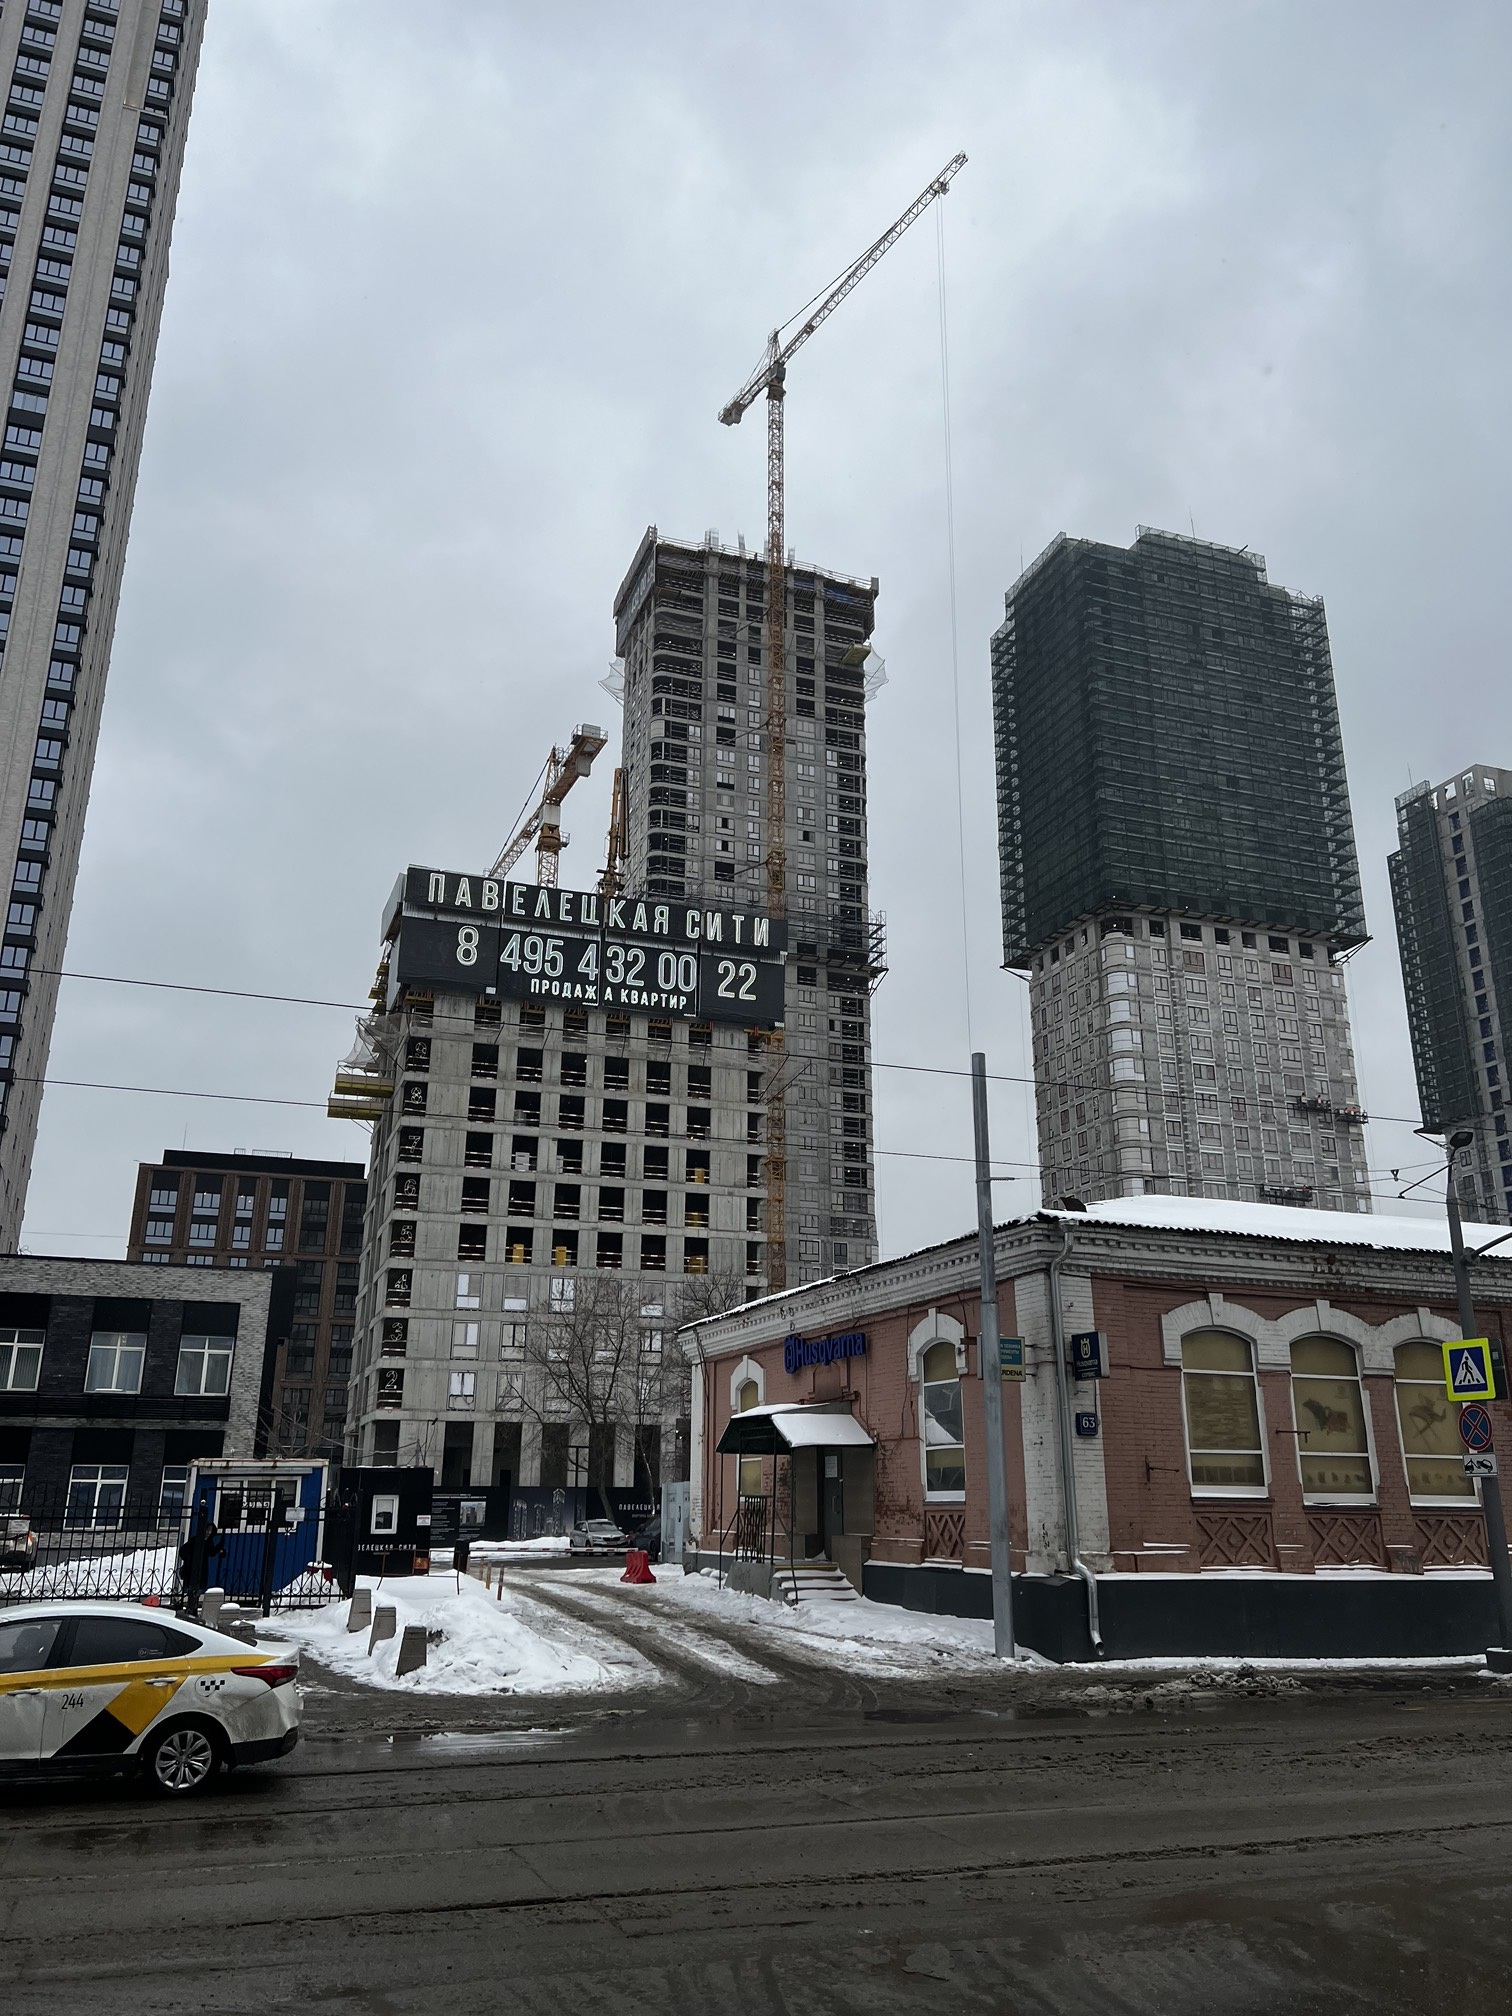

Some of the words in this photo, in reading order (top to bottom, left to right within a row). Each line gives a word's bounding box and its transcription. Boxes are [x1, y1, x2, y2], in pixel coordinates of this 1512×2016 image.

[428, 873, 670, 935] ПАВЕЛЕЦКАЯ
[686, 909, 770, 947] СИТИ
[456, 925, 480, 967] 8
[500, 933, 564, 977] 495
[577, 943, 646, 987] 432
[658, 952, 697, 992] 00
[717, 960, 757, 1001] 22
[531, 978, 613, 1001] ПРОДАЖА
[620, 988, 687, 1010] КВАРТИР
[410, 1087, 423, 1104] 8
[408, 1135, 421, 1153] 7
[404, 1179, 417, 1196] 6
[400, 1225, 413, 1243] 5
[394, 1273, 408, 1290] 4
[390, 1322, 403, 1341] 3
[795, 1332, 866, 1368] Husqvarna
[385, 1370, 398, 1389] 2
[1001, 1369, 1023, 1377] RDENA
[1082, 1416, 1096, 1428] 63
[61, 1693, 84, 1710] 244
